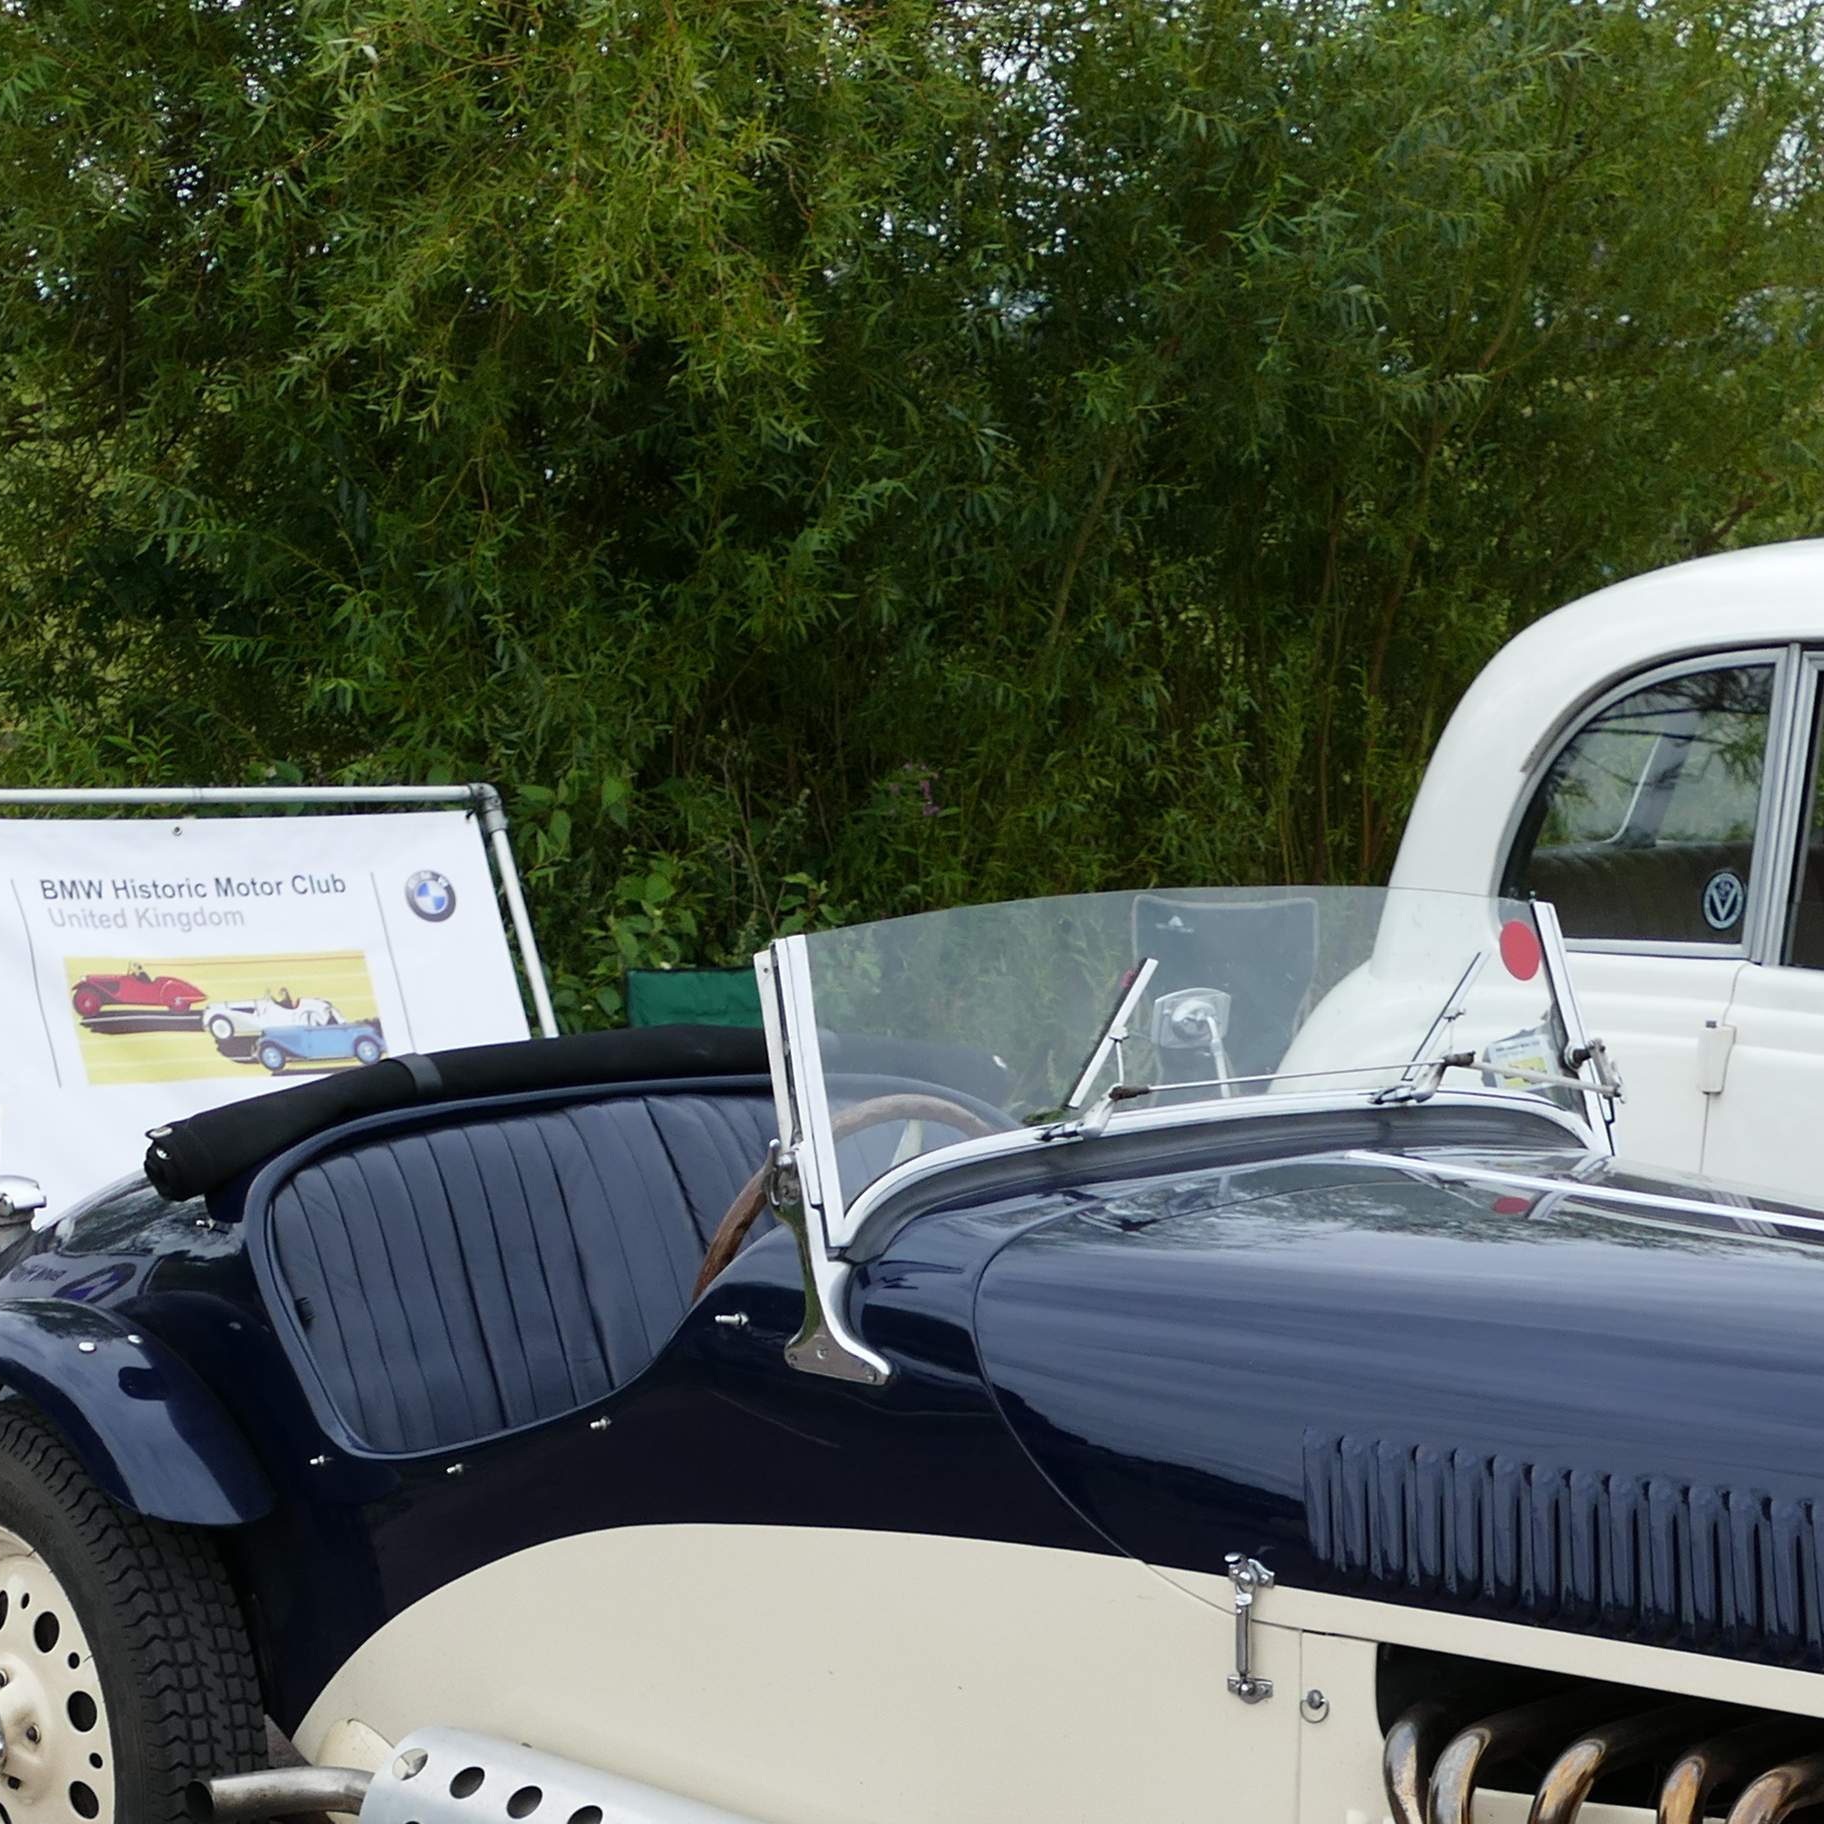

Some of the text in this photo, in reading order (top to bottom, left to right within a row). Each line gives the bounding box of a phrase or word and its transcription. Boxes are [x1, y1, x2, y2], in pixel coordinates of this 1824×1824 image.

[40, 873, 346, 900] BMW Historic Motor Club
[48, 906, 245, 933] United Kingdom
